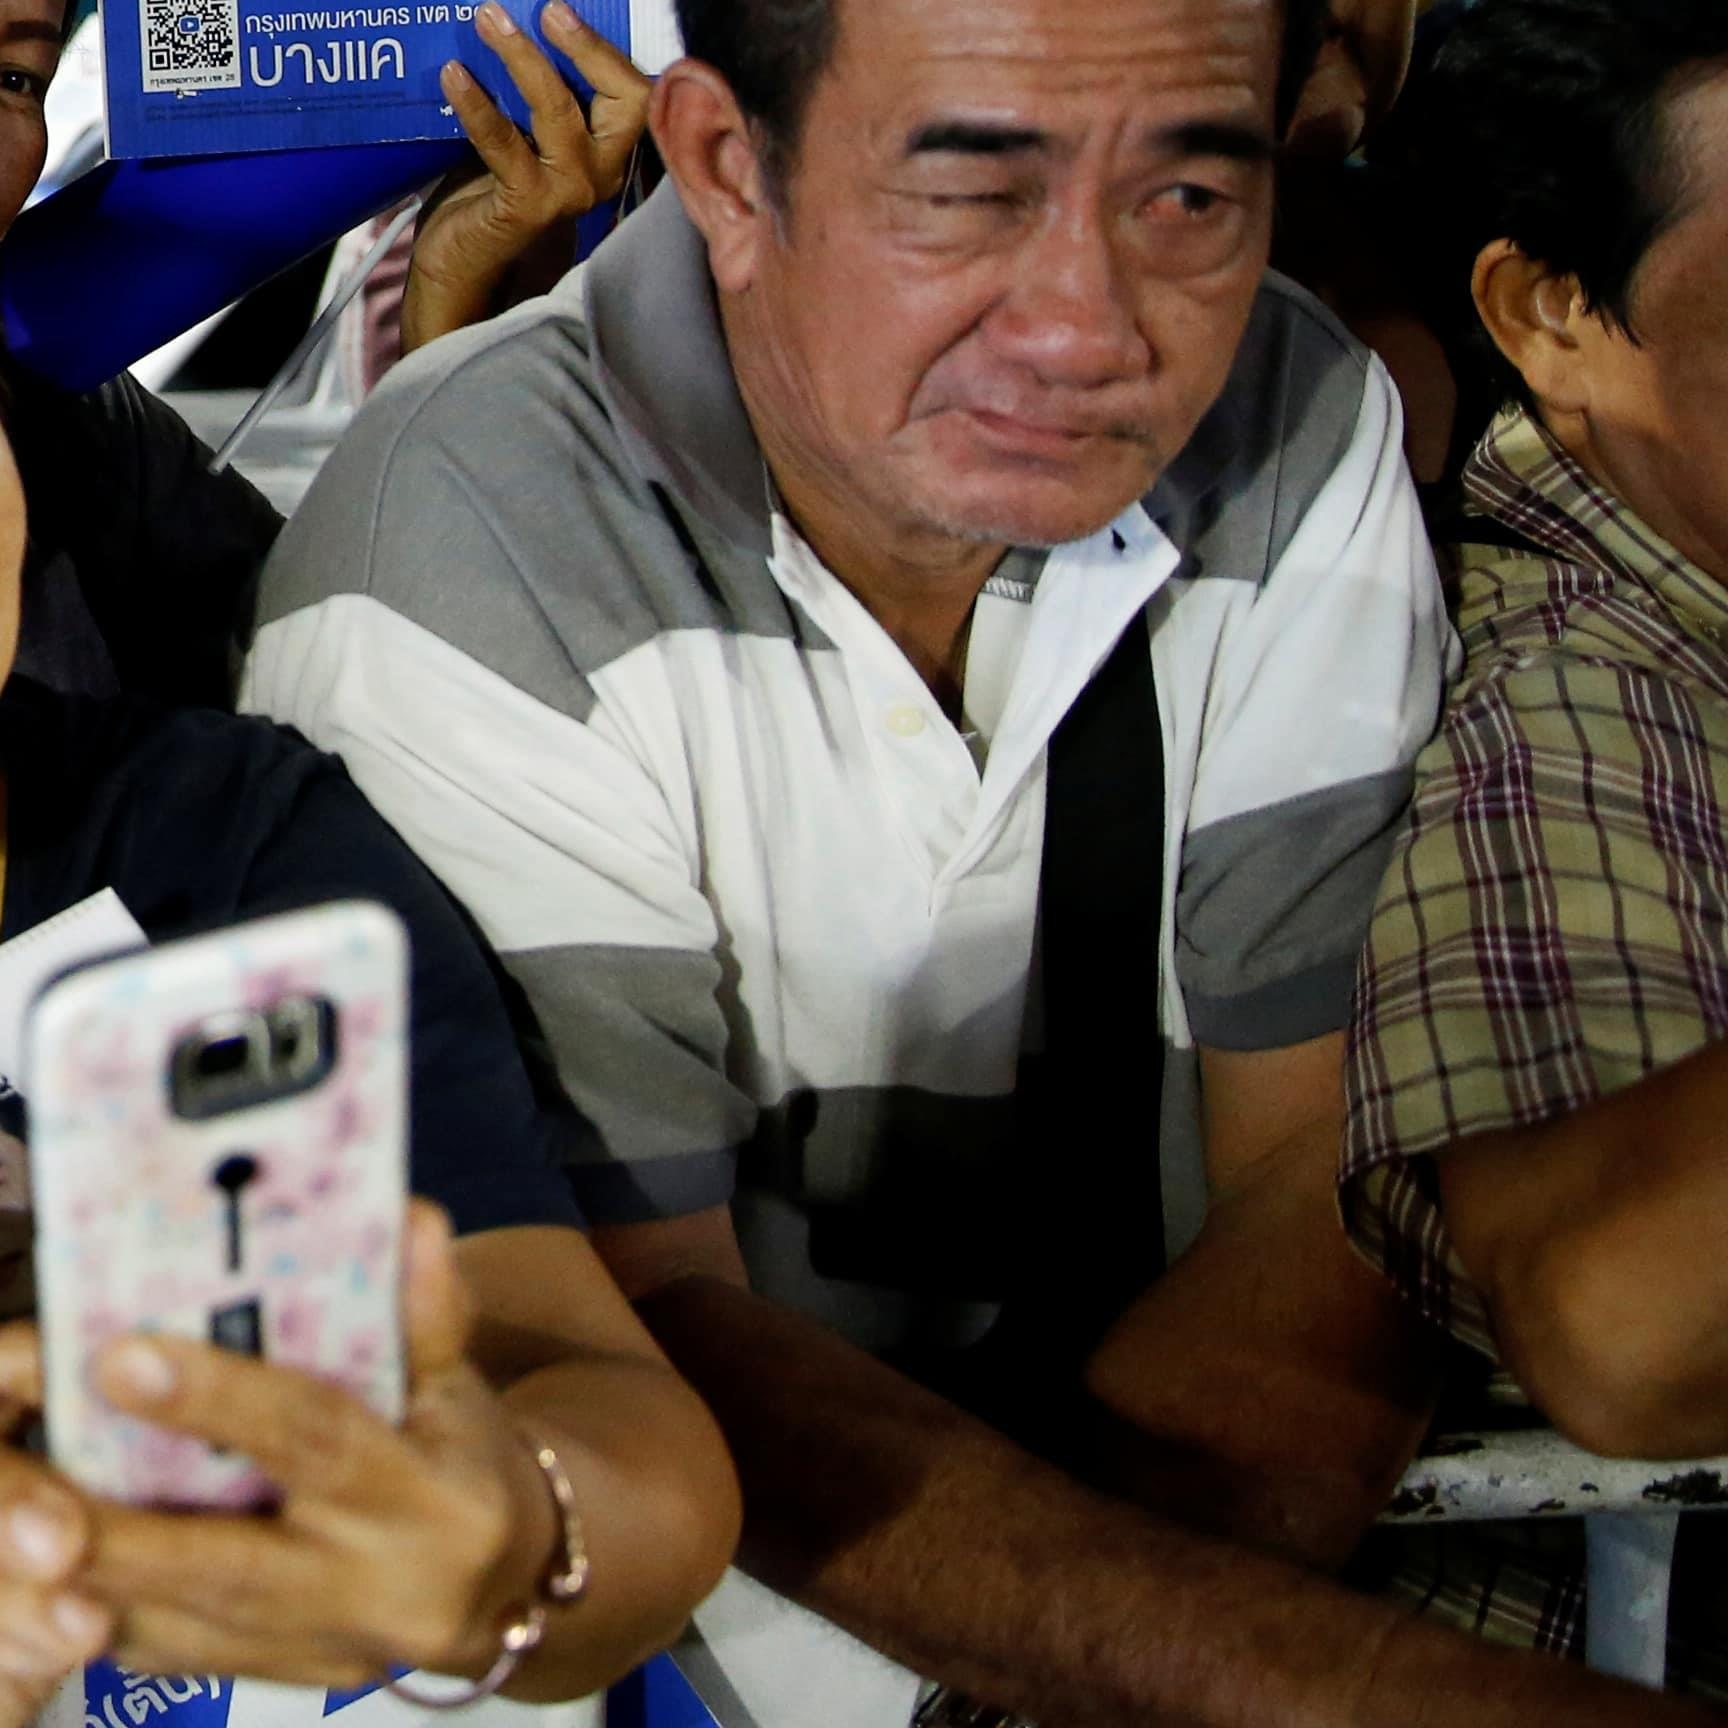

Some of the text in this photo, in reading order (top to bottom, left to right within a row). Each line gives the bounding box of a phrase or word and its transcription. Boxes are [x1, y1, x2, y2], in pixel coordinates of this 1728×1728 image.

[246, 4, 480, 40] กรุงเทพมหานคร เขต ๒
[250, 37, 406, 87] บางแค
